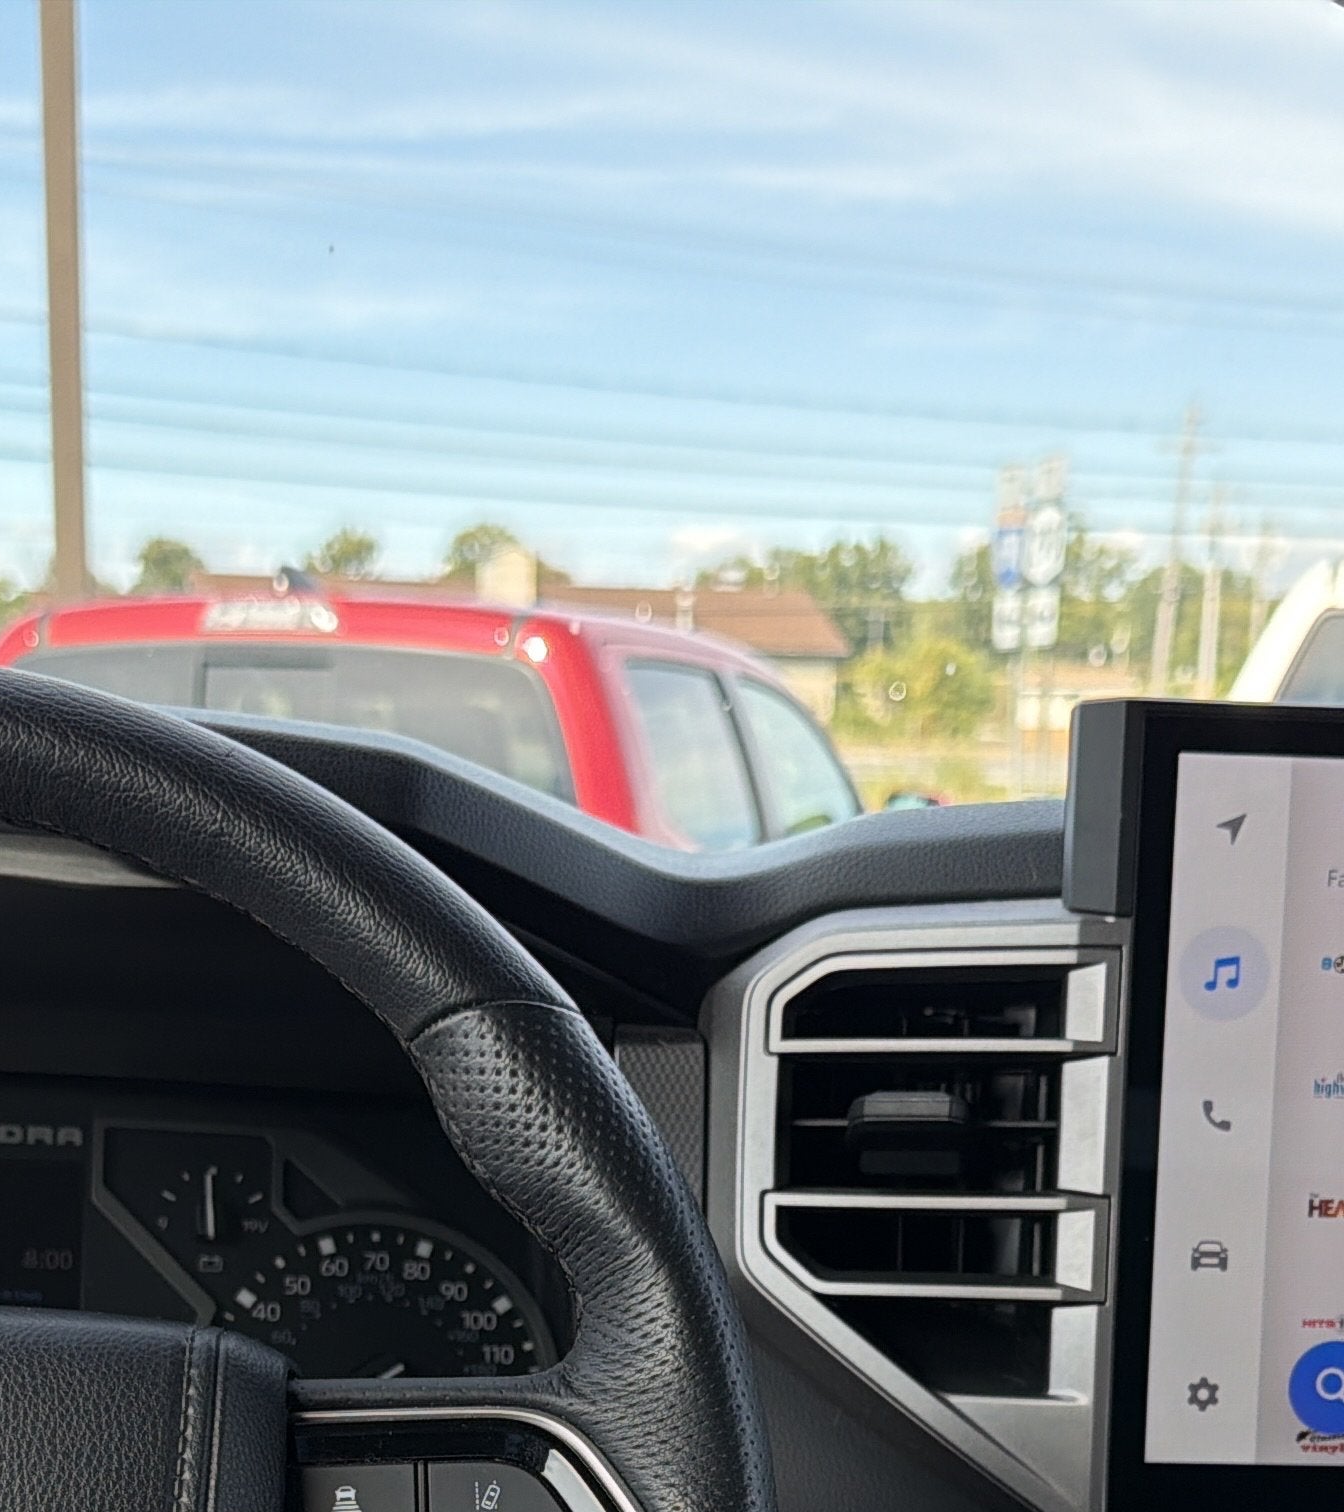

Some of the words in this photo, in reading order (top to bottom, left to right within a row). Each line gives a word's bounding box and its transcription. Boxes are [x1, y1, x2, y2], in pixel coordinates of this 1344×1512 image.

[319, 1256, 350, 1278] 60
[363, 1250, 391, 1272] 70
[402, 1260, 432, 1281] 80
[282, 1274, 312, 1296] 50
[439, 1280, 469, 1302] 90
[252, 1303, 282, 1323] 40
[460, 1311, 498, 1331] 100
[482, 1344, 515, 1366] 110
